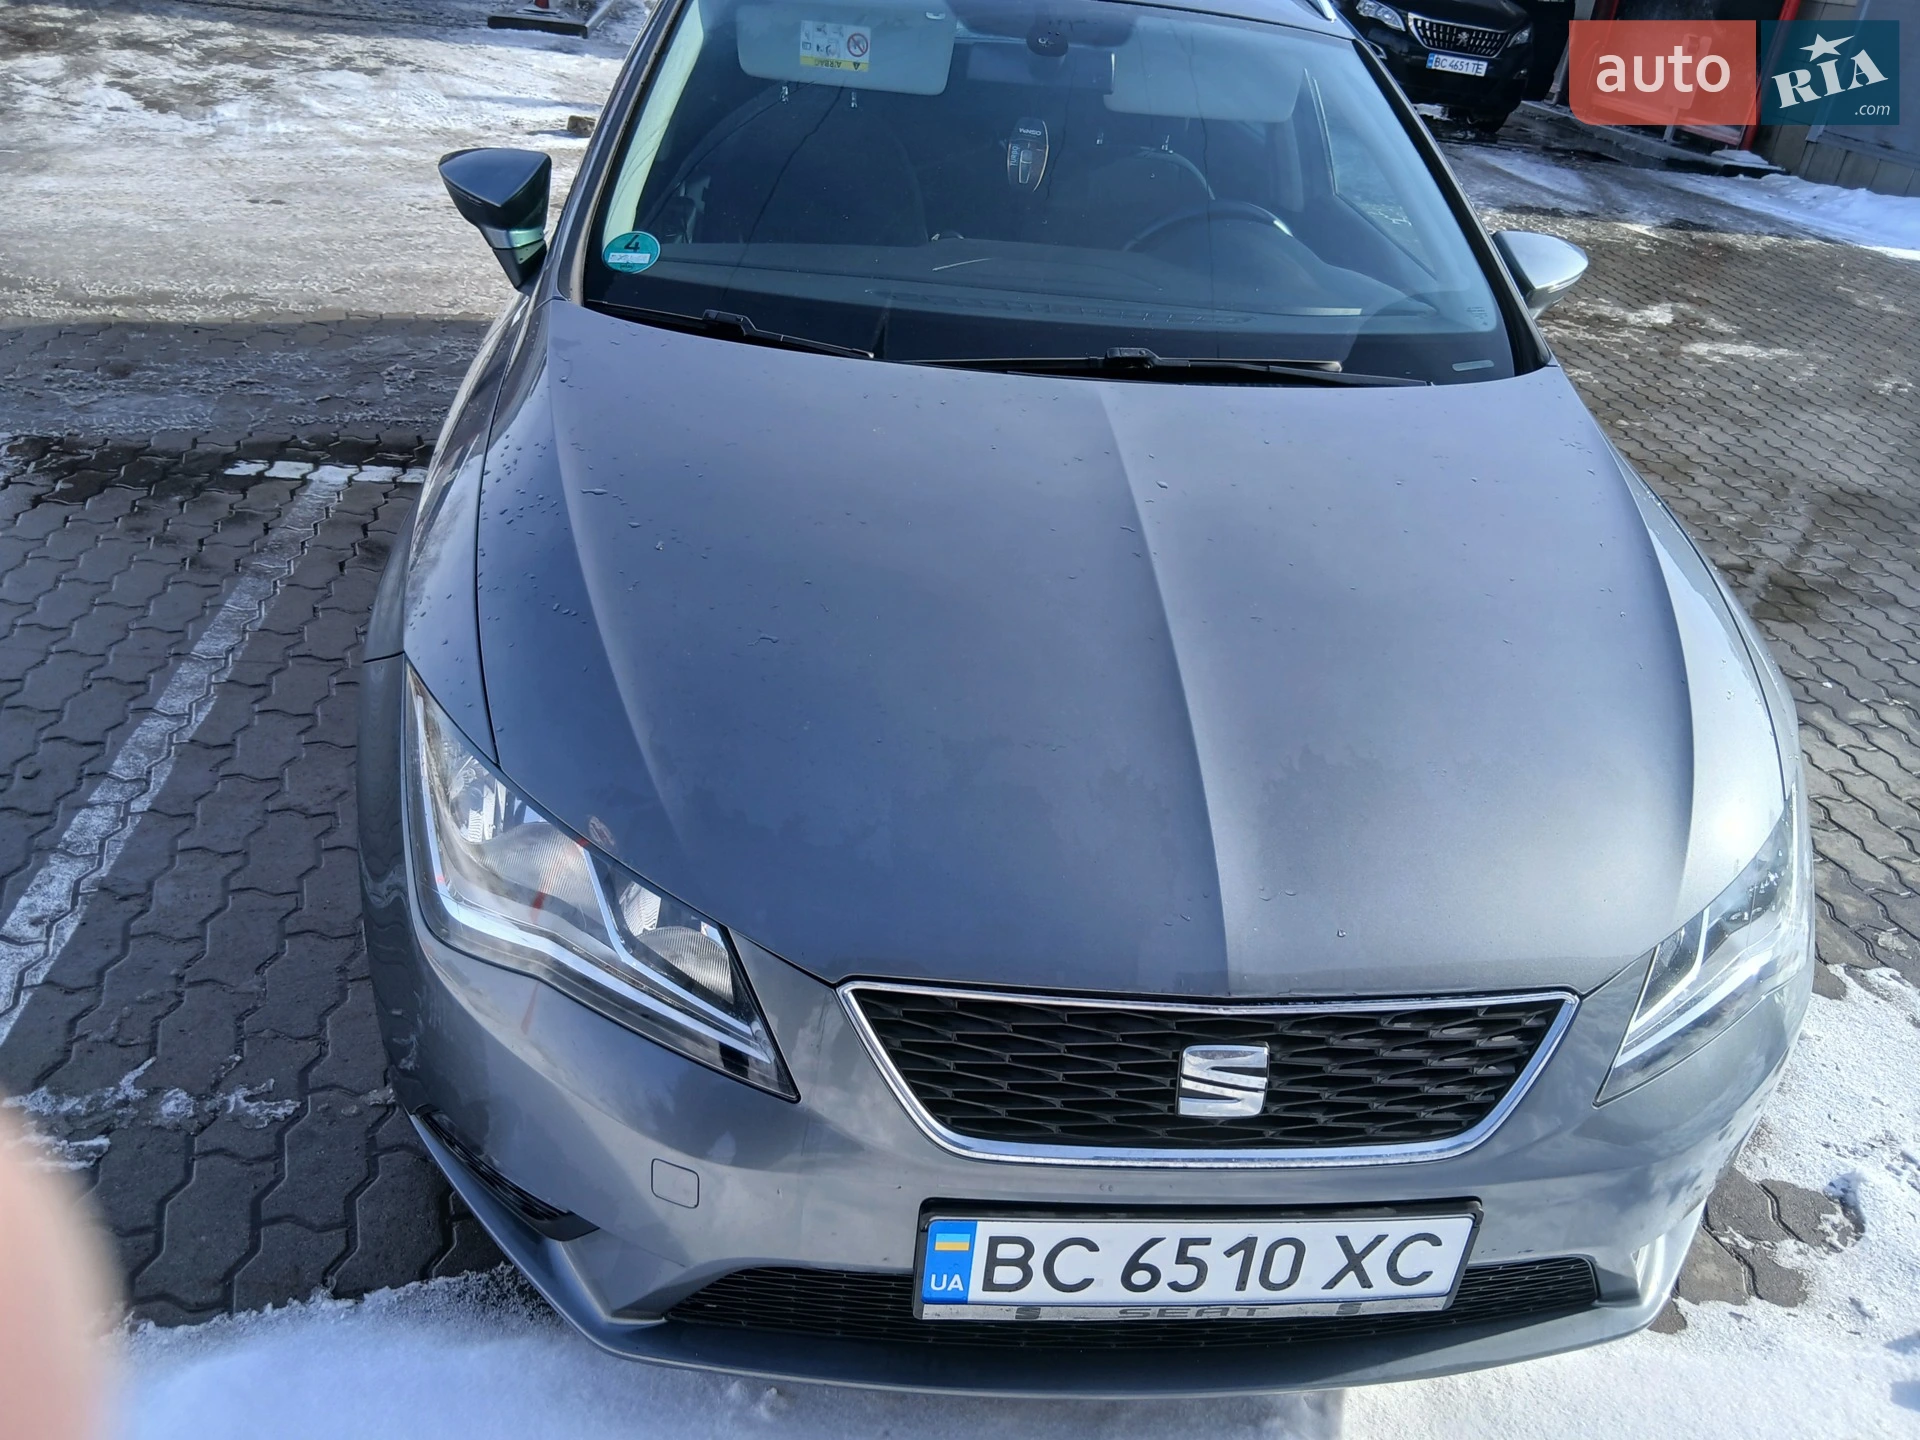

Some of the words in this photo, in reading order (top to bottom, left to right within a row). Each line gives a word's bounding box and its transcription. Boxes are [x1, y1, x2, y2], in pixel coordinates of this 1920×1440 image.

[1434, 56, 1447, 69] BC
[1449, 60, 1469, 72] 4651
[624, 234, 640, 253] 4
[982, 1236, 1100, 1293] BC
[1120, 1236, 1306, 1293] 6510
[1321, 1232, 1443, 1290] XC
[930, 1273, 964, 1291] UA
[1118, 1307, 1269, 1319] SEAT
